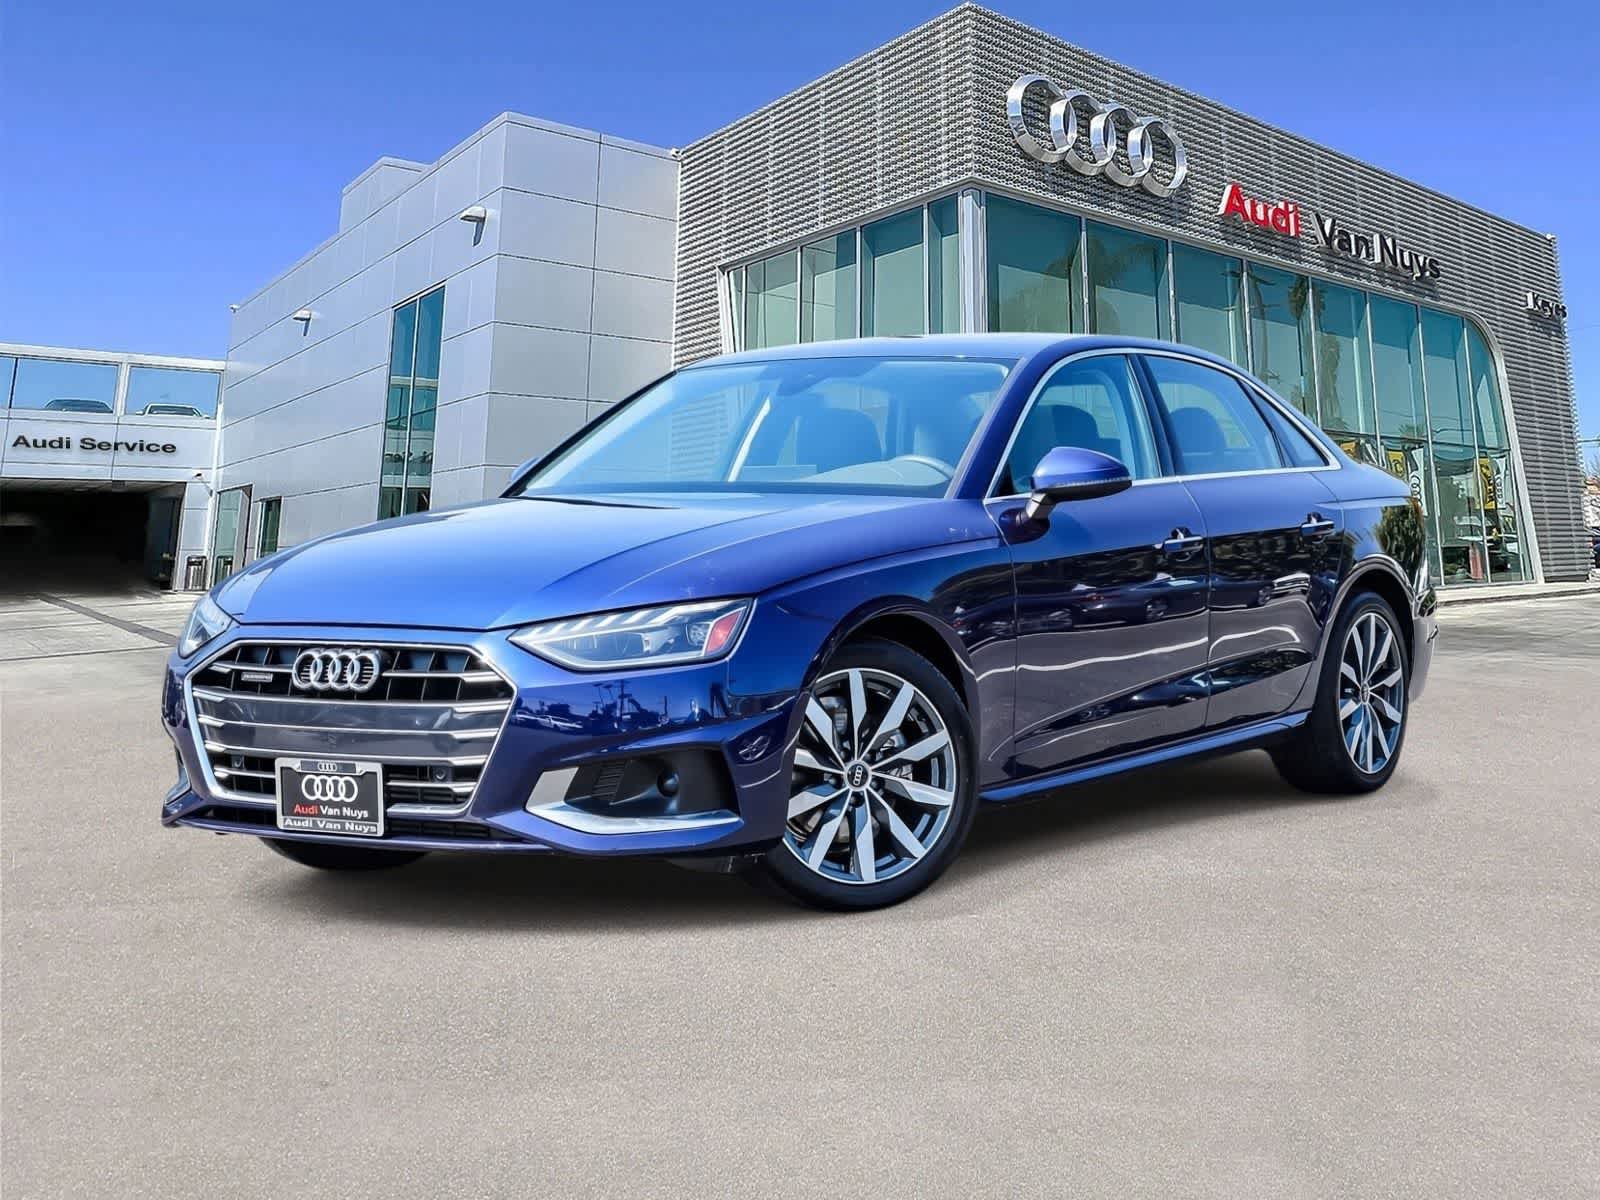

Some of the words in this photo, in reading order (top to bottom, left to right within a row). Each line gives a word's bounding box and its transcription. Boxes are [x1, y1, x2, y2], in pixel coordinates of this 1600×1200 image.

[1218, 183, 1301, 238] Audi
[1312, 212, 1370, 258] Van
[1374, 233, 1441, 281] Nuys
[12, 435, 71, 450] Audi
[79, 437, 177, 454] Service
[294, 804, 318, 815] Audi
[320, 805, 340, 816] Van
[342, 806, 369, 819] Nuys
[284, 818, 313, 828] Audi
[317, 820, 341, 831] Van
[345, 822, 377, 834] Nuys
